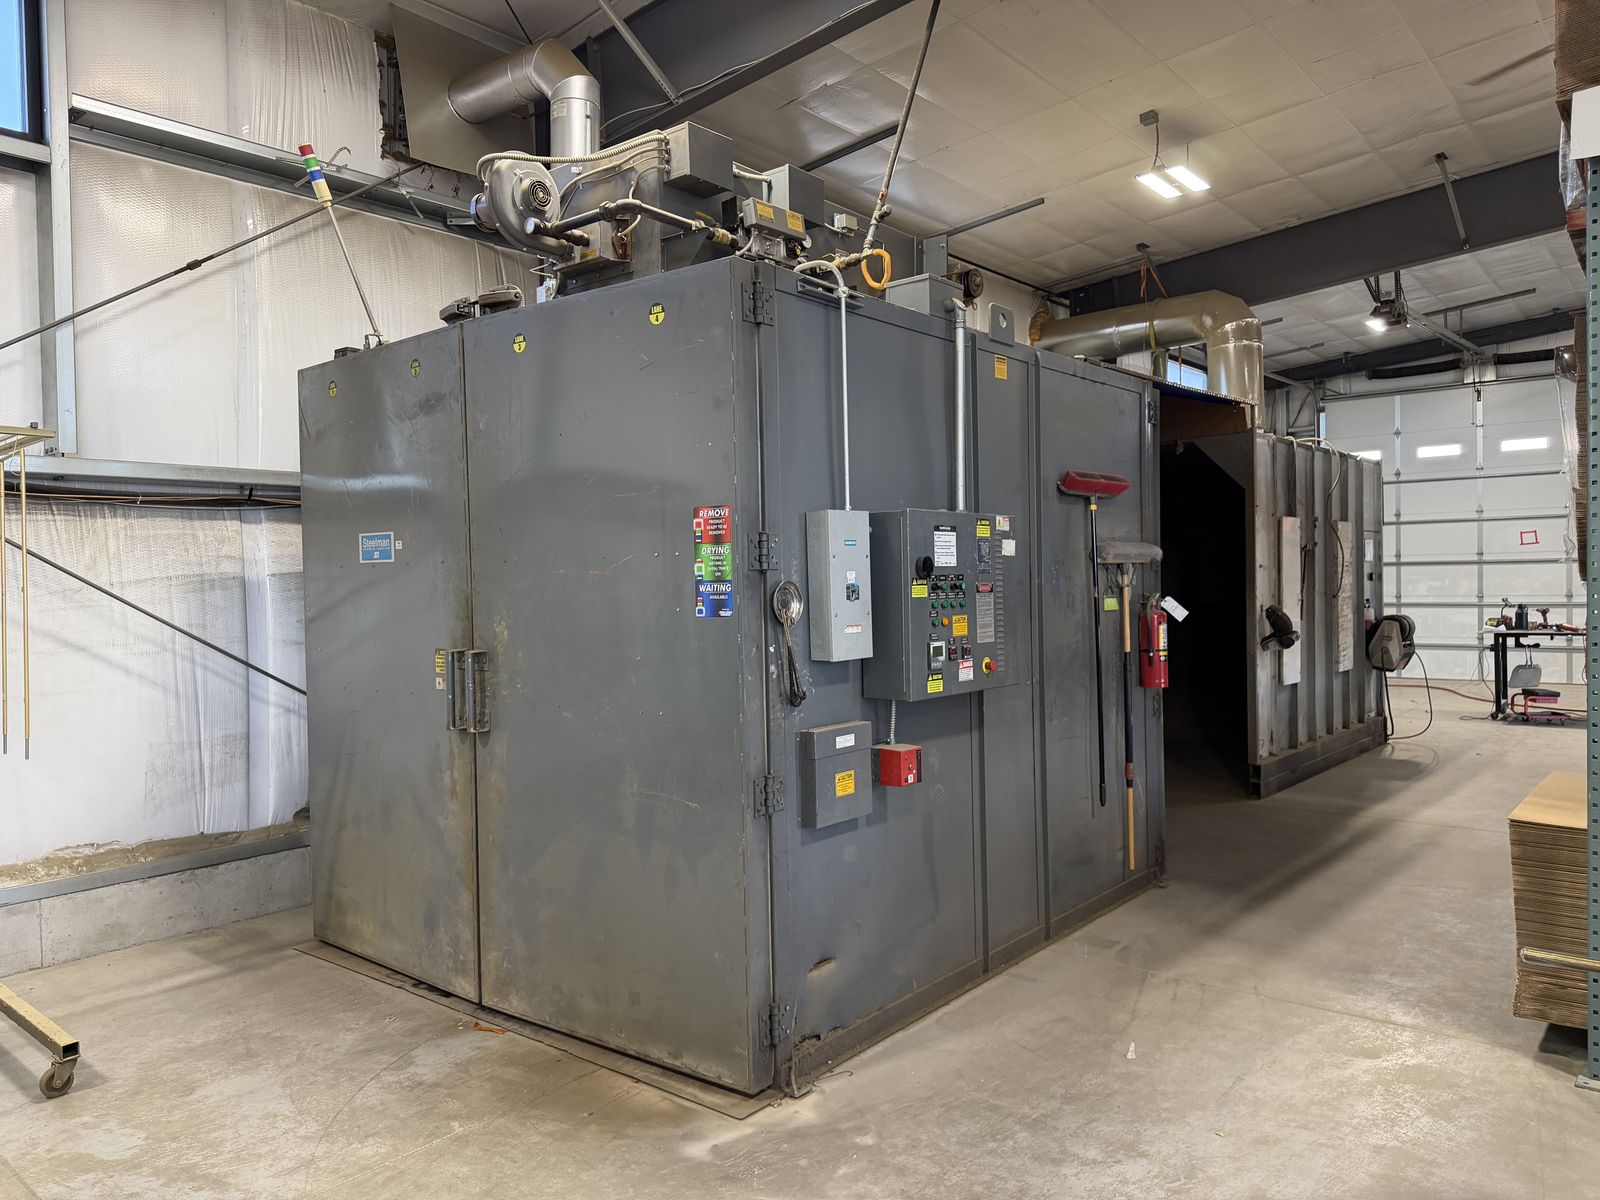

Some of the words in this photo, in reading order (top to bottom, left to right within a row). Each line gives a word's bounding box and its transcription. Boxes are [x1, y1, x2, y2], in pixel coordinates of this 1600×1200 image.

[651, 304, 663, 314] LANE
[699, 508, 730, 518] REMOVE
[362, 538, 390, 549] Steelman
[701, 546, 730, 555] DRYING
[698, 583, 732, 592] WAITING
